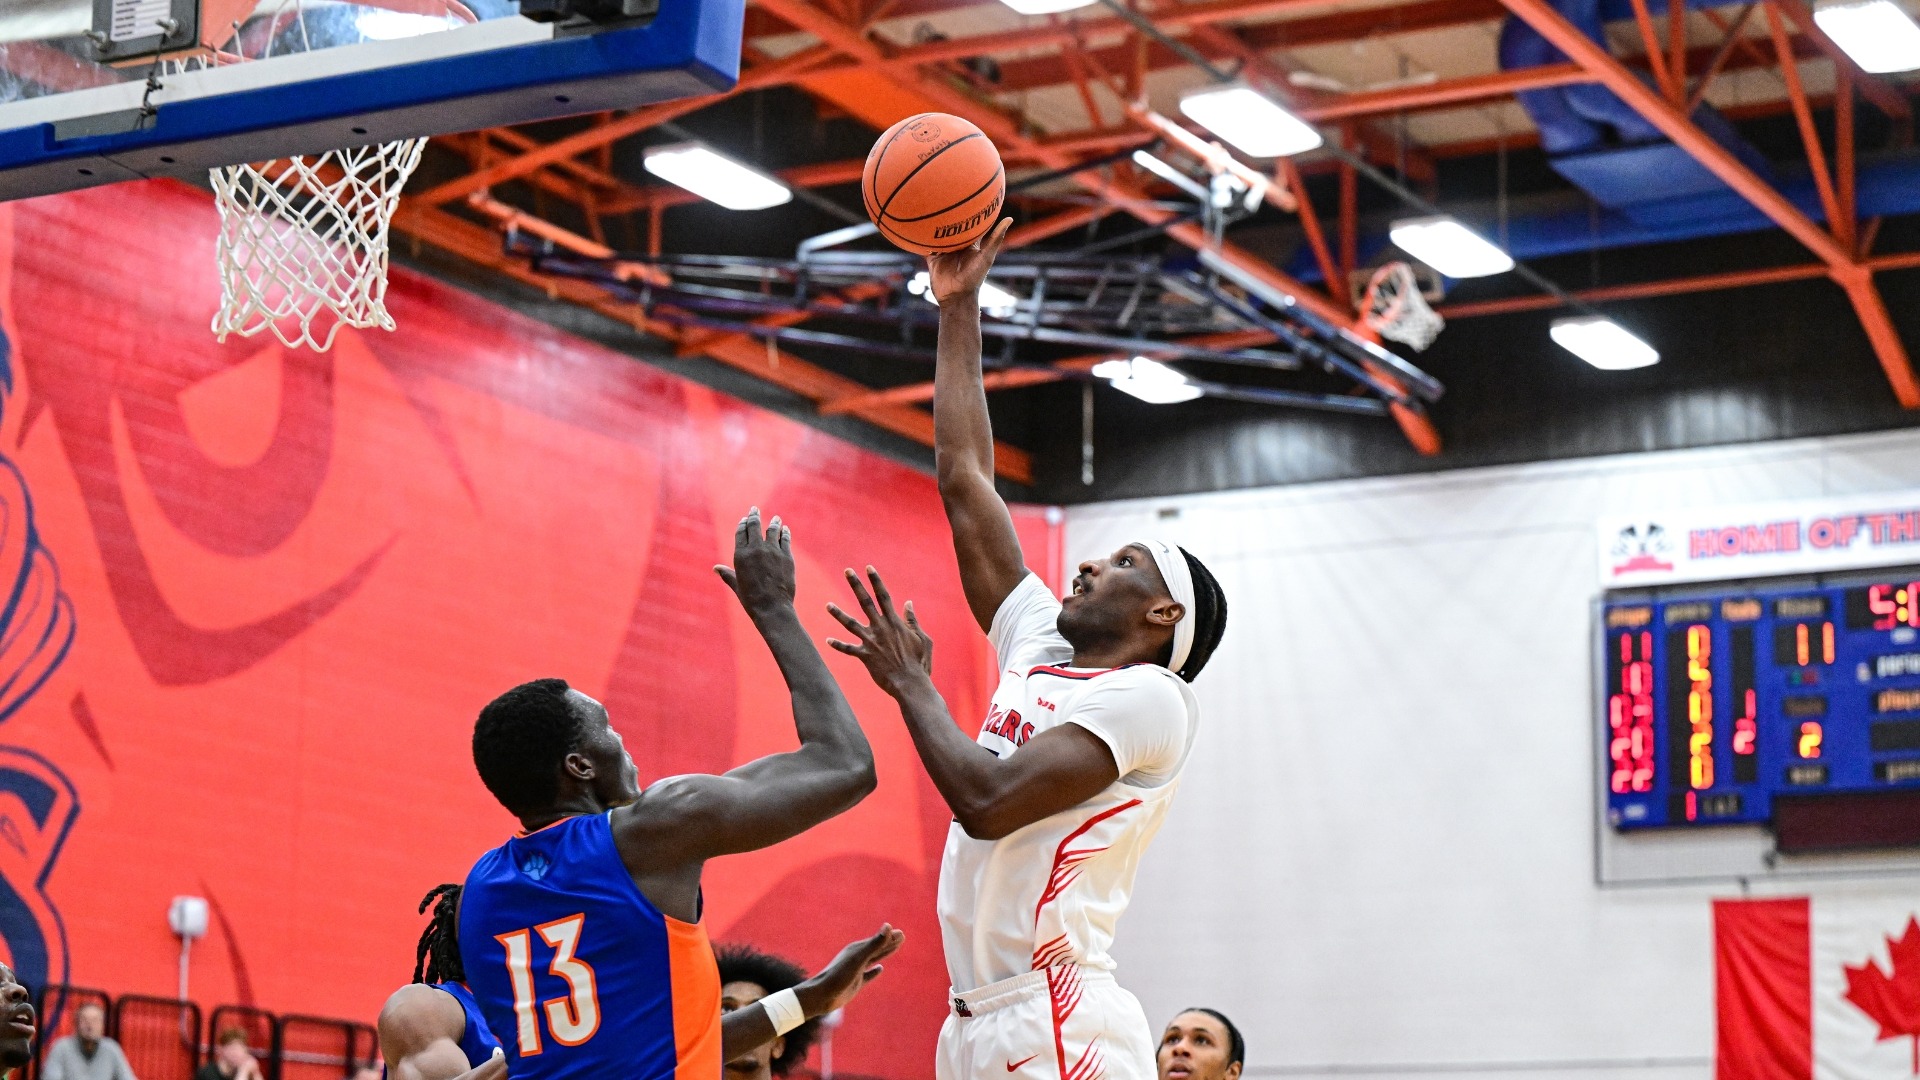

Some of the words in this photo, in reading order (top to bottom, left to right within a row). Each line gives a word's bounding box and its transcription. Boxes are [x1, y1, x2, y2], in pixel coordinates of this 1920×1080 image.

[1689, 521, 1800, 559] HOME
[1809, 517, 1857, 549] OF
[1866, 510, 1920, 545] TH
[1796, 622, 1835, 666] 11
[1799, 721, 1823, 758] 2
[494, 912, 601, 1057] 13
